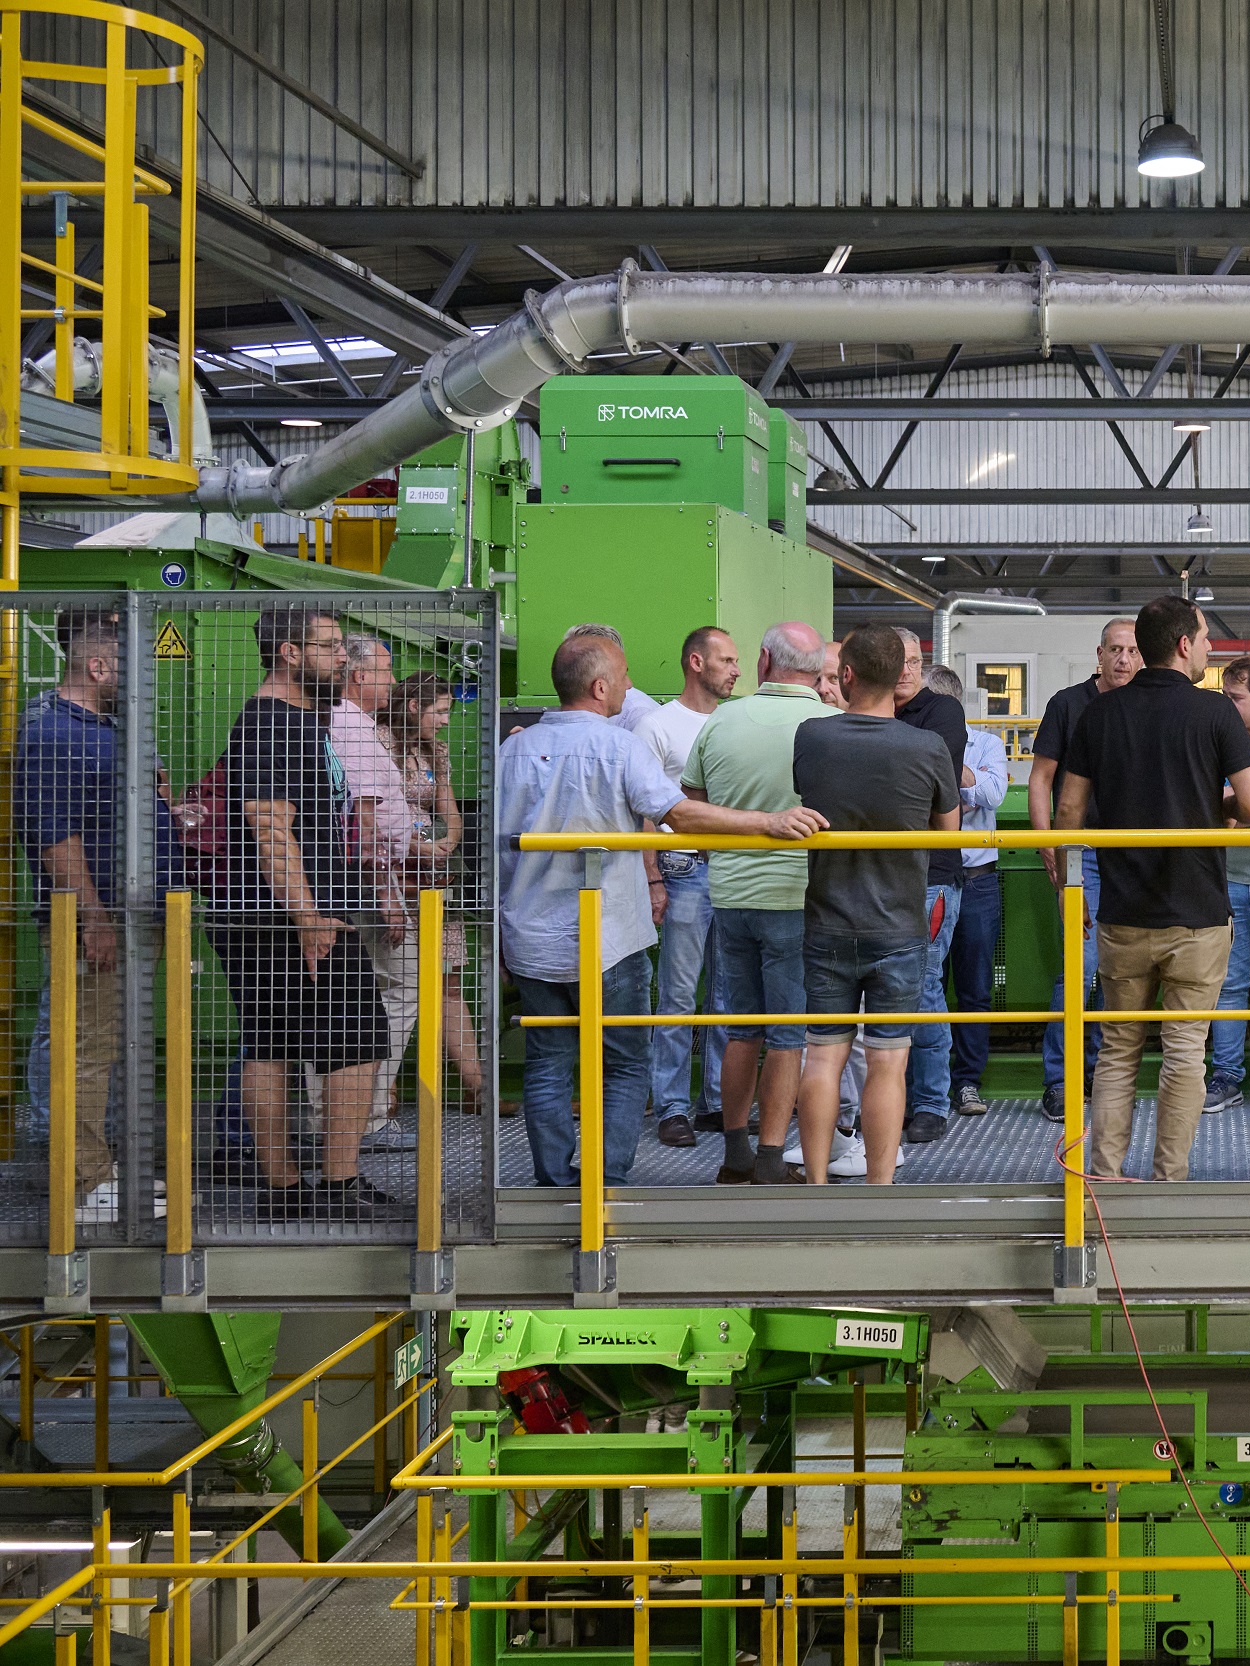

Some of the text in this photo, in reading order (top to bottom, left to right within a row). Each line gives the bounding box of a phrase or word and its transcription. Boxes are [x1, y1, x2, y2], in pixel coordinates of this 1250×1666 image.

[618, 406, 689, 420] TOMRA
[409, 490, 445, 500] 2.1H050
[578, 1331, 657, 1345] SPALECK
[843, 1325, 897, 1343] 3.1H050
